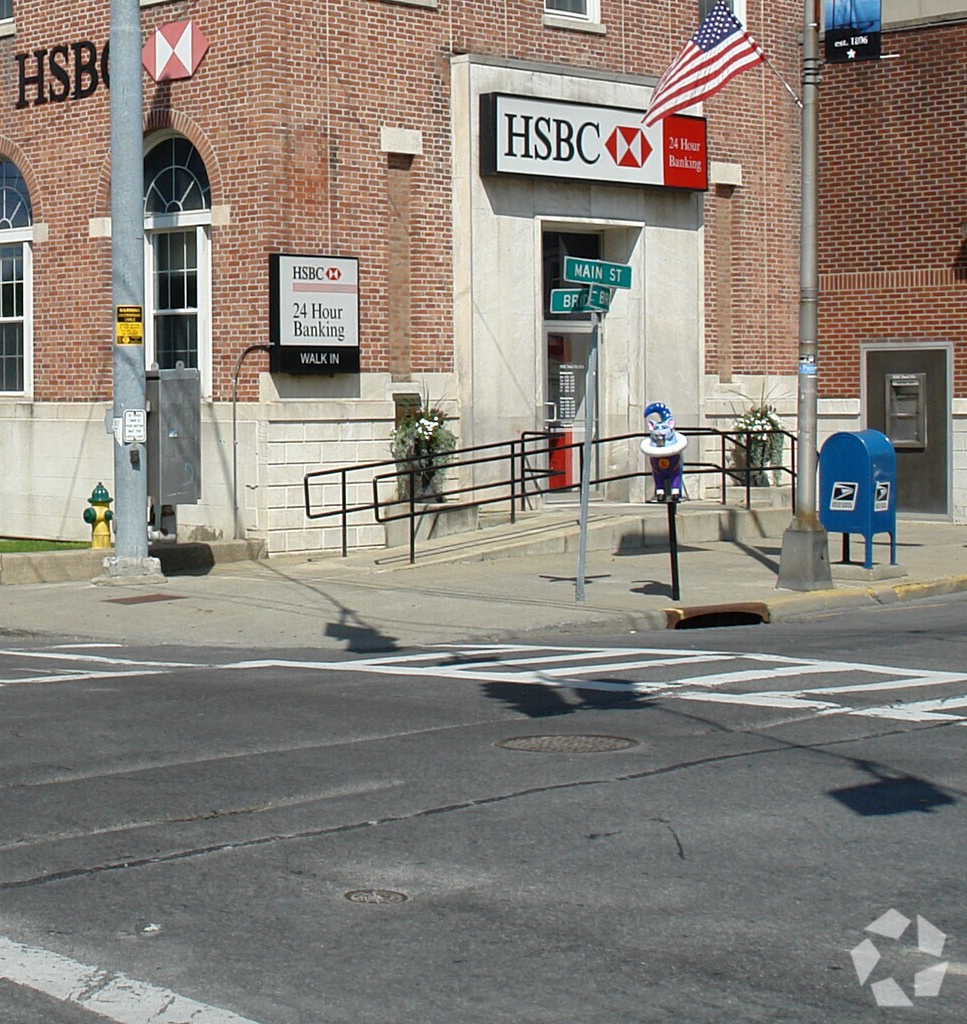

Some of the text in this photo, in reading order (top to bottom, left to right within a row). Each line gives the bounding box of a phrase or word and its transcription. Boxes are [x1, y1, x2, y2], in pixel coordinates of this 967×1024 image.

[834, 39, 849, 47] est.
[15, 40, 111, 109] HSB
[504, 113, 601, 165] HSBC
[669, 136, 701, 152] 24 Hour
[669, 154, 702, 173] Banking
[292, 266, 324, 281] HSBC
[574, 263, 622, 282] MAIN ST
[293, 302, 343, 319] 24 Hour
[294, 321, 345, 341] Banking
[300, 353, 340, 364] WALK IN
